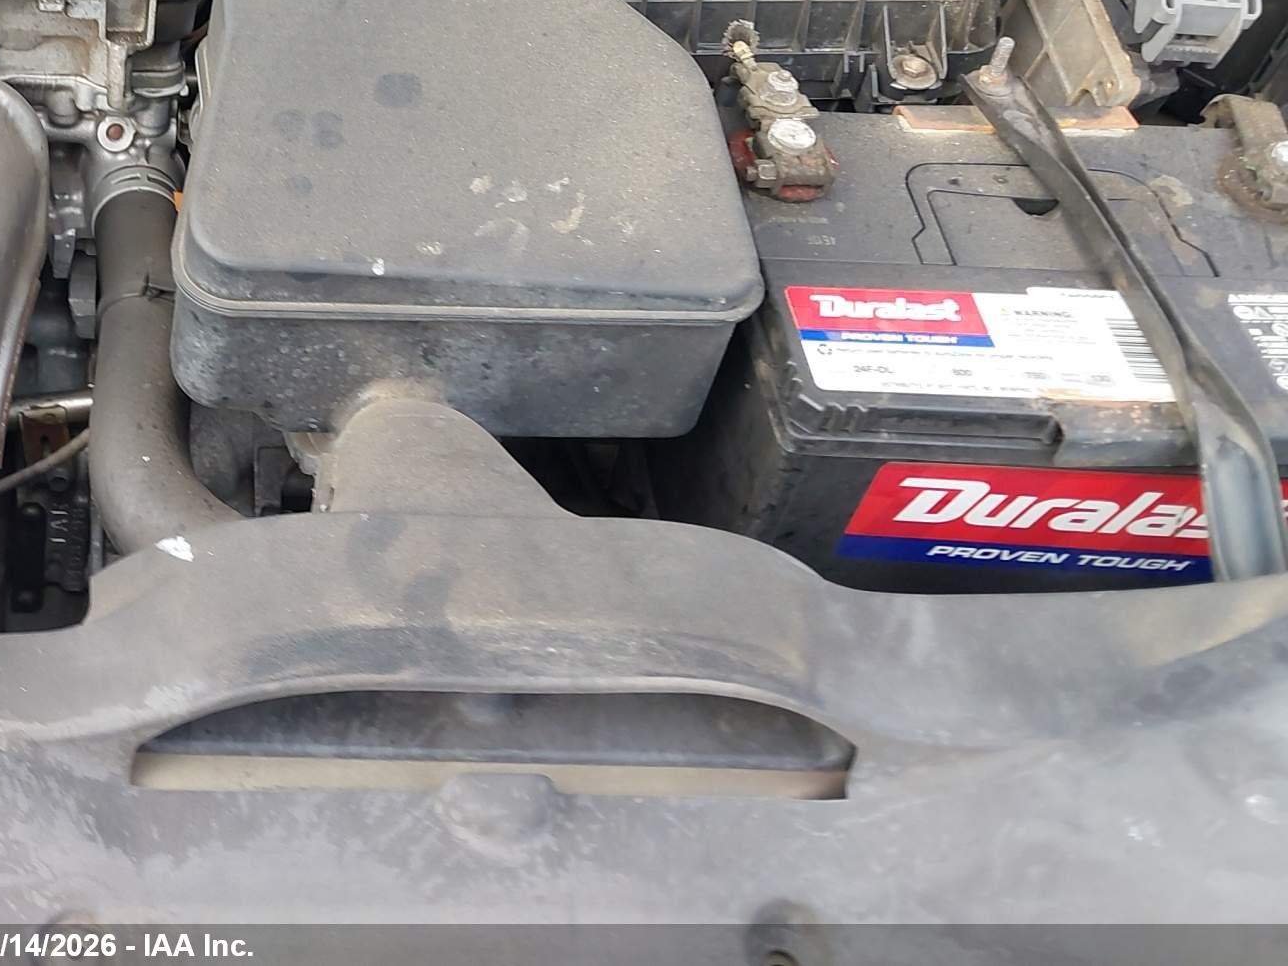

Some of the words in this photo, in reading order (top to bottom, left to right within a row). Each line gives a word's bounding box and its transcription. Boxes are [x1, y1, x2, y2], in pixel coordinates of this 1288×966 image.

[809, 294, 962, 322] Duralast
[841, 332, 904, 342] PROVEN
[905, 333, 958, 344] TOUGH
[893, 476, 1209, 539] Duralas
[926, 545, 1069, 565] PROVEN
[1078, 553, 1191, 572] TOUGH
